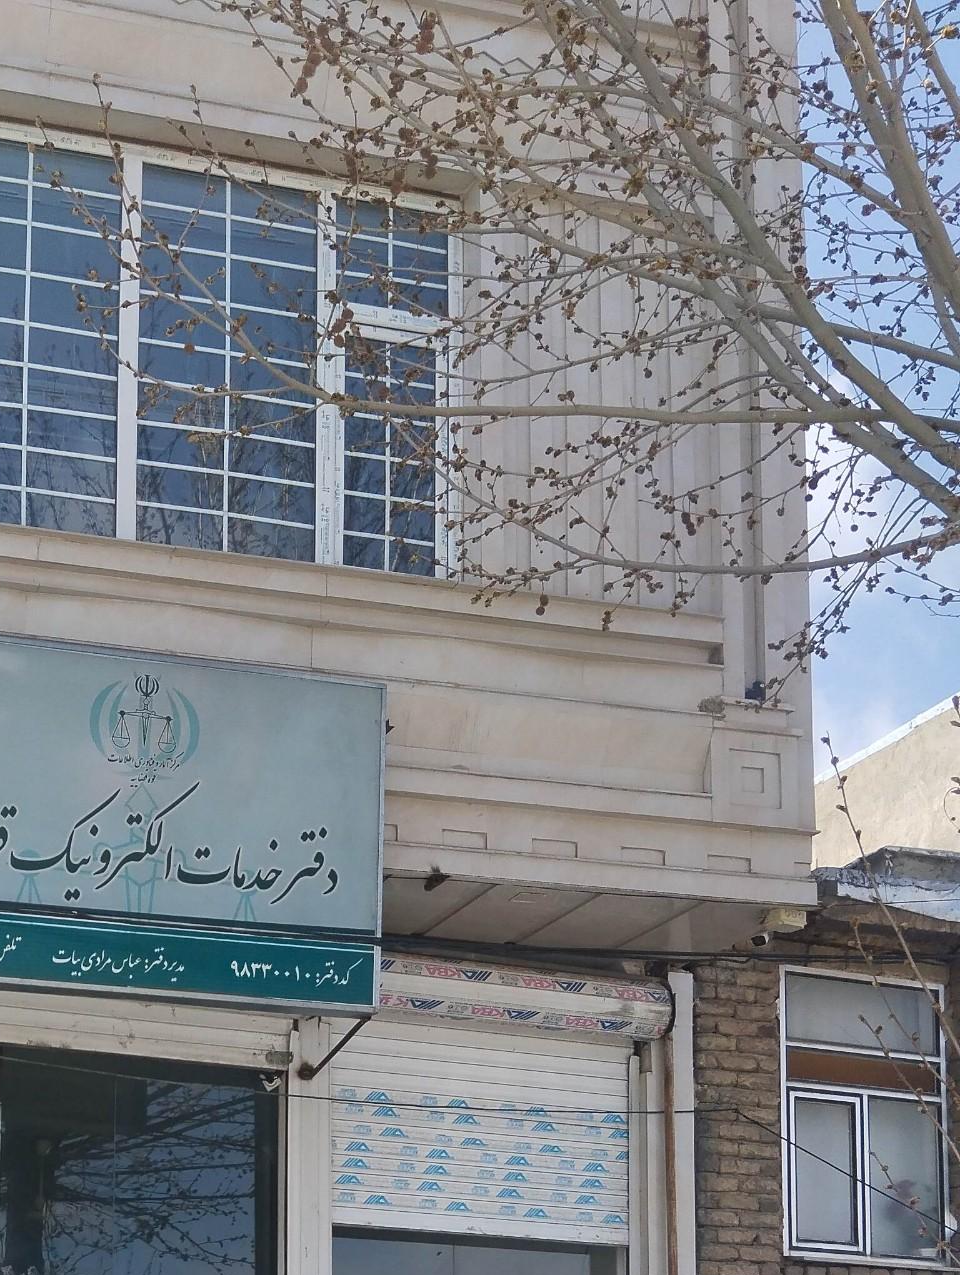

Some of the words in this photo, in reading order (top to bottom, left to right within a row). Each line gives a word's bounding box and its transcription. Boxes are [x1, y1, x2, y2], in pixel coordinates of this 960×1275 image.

[9, 780, 201, 901] الکترونیک
[176, 839, 284, 890] خدمات
[270, 826, 339, 905] دفتر
[52, 949, 81, 976] بیات
[80, 949, 112, 971] مرادی
[110, 953, 142, 979] عباس
